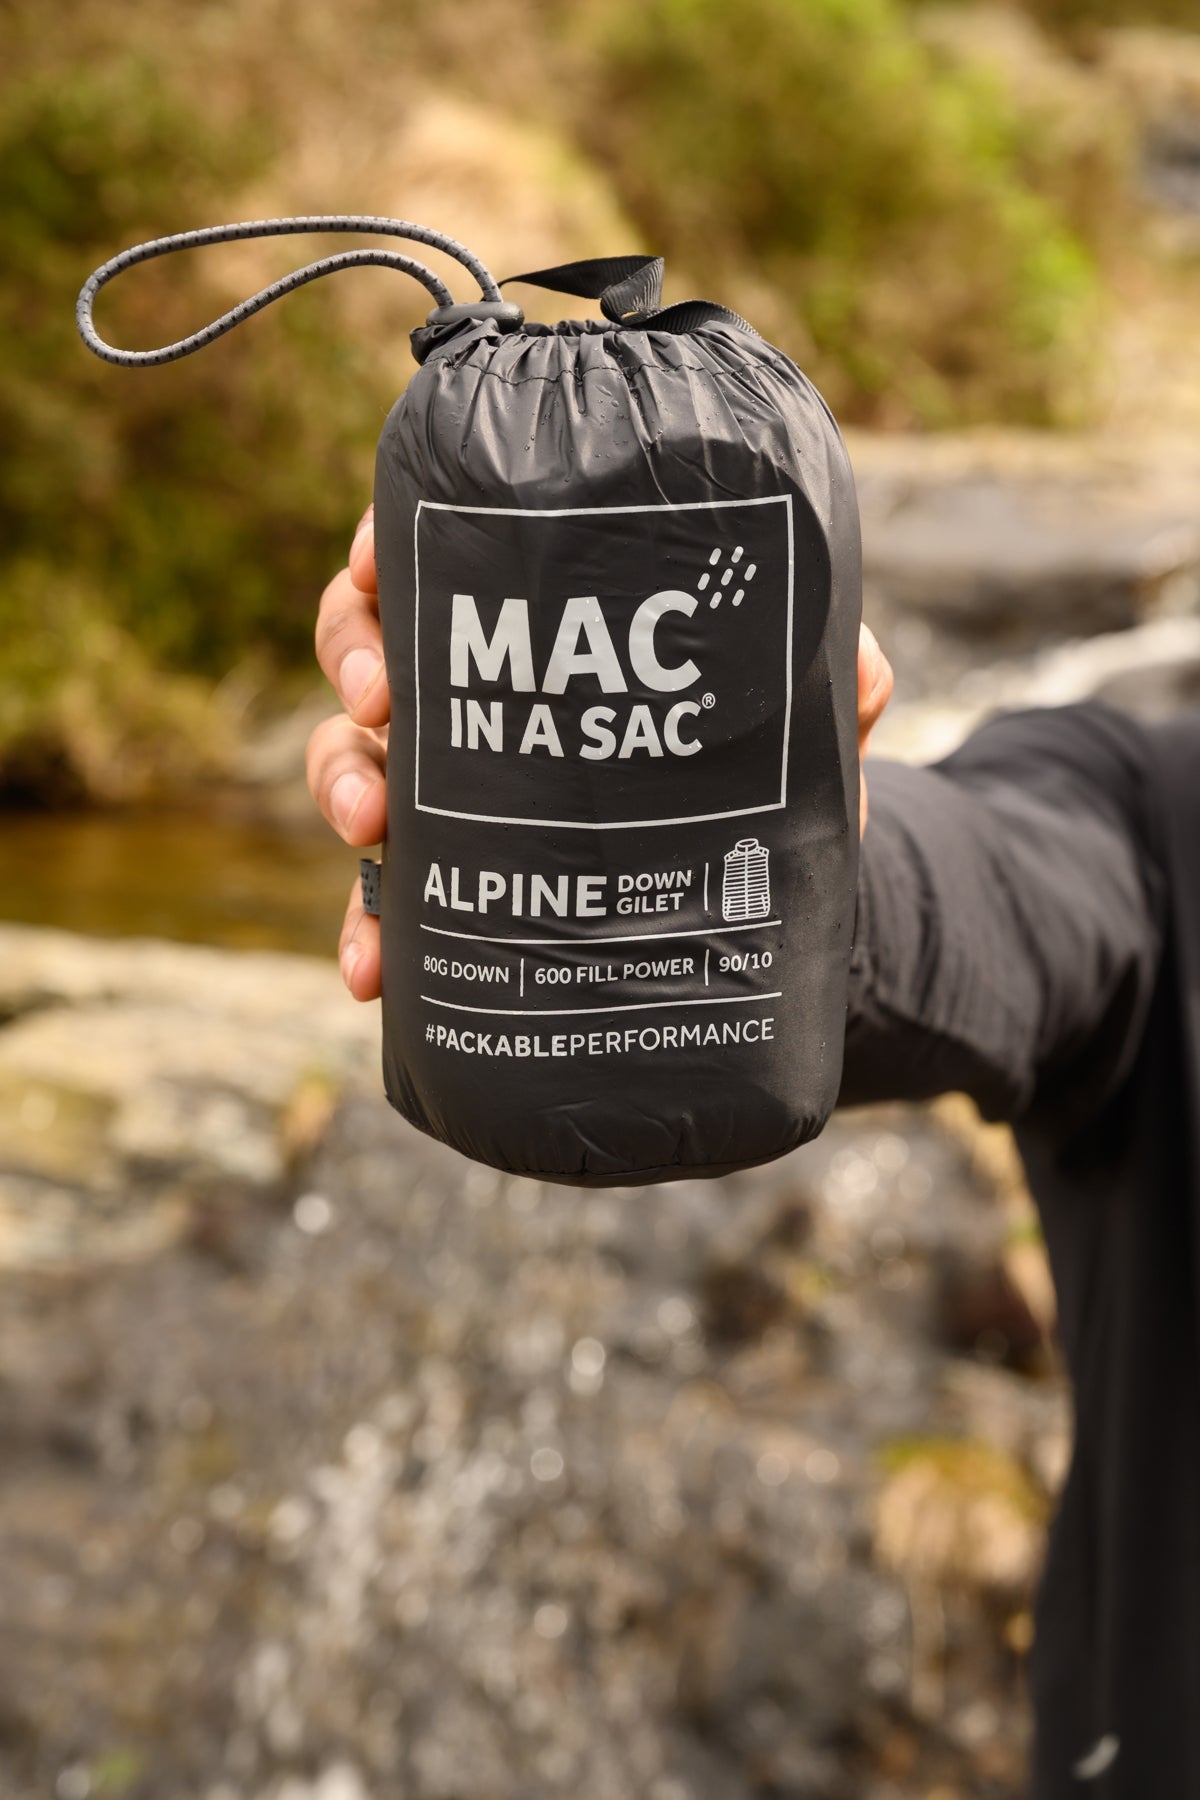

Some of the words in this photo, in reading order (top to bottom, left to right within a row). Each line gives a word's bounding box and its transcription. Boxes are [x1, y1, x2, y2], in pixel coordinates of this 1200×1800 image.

[450, 590, 701, 694] MAC
[451, 698, 503, 752] IN
[519, 704, 564, 757] A
[424, 863, 607, 916] ALPINE
[617, 870, 692, 892] DOWN
[617, 891, 684, 914] GILET
[423, 955, 448, 976] 80G
[451, 961, 510, 984] DOWN
[534, 967, 572, 985] 600
[576, 964, 619, 984] FILL
[623, 957, 695, 980] POWER
[719, 951, 773, 973] 90/10
[426, 1018, 774, 1057] #PACKABLEPERFORMANCE
